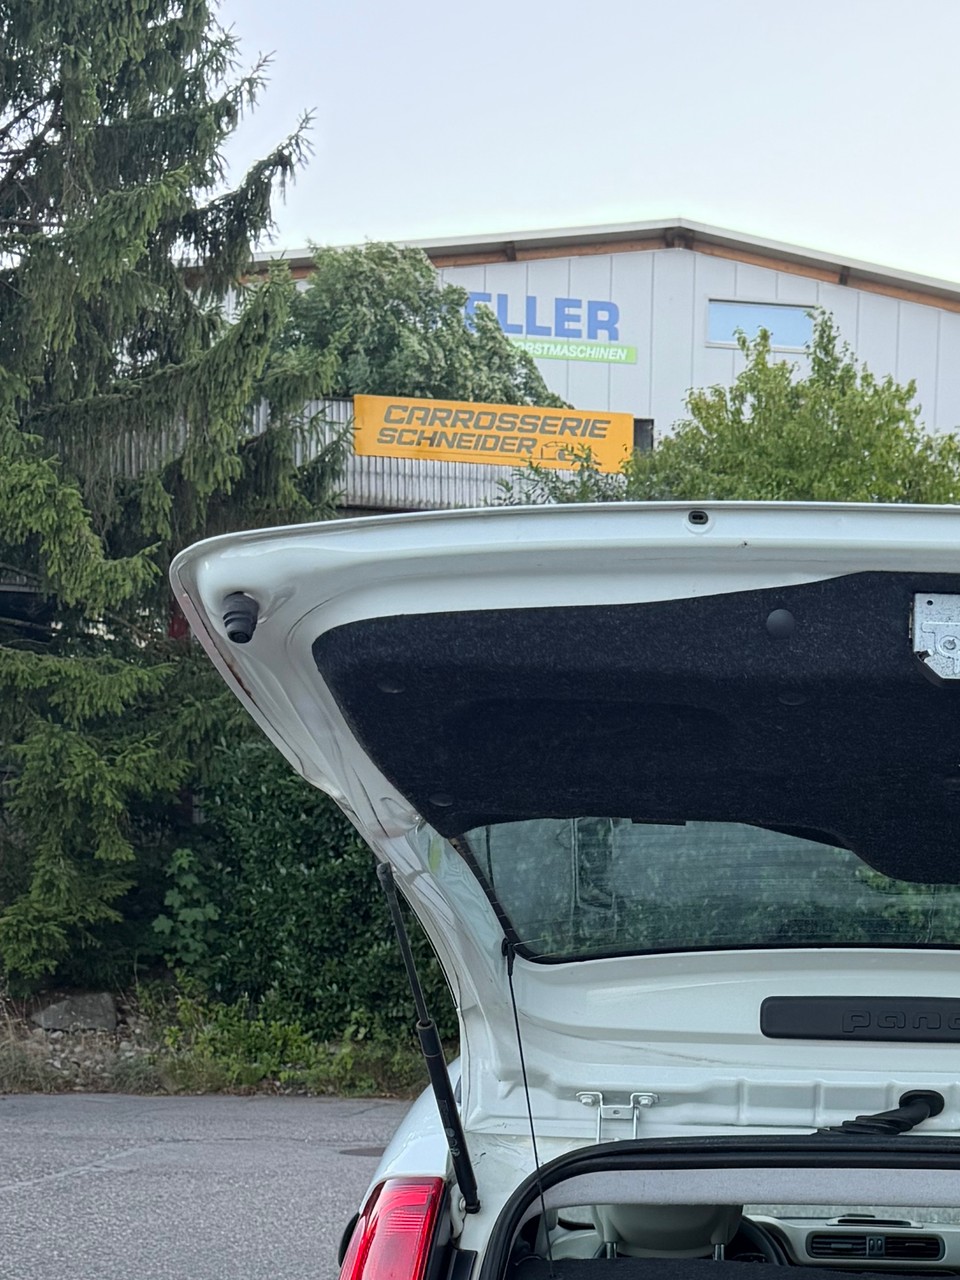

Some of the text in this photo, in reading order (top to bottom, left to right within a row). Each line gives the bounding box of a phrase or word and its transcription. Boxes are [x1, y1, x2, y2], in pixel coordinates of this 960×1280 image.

[464, 291, 620, 341] ELLER
[383, 404, 611, 439] CARROSSERIE
[377, 427, 538, 455] SCHNEIDER
